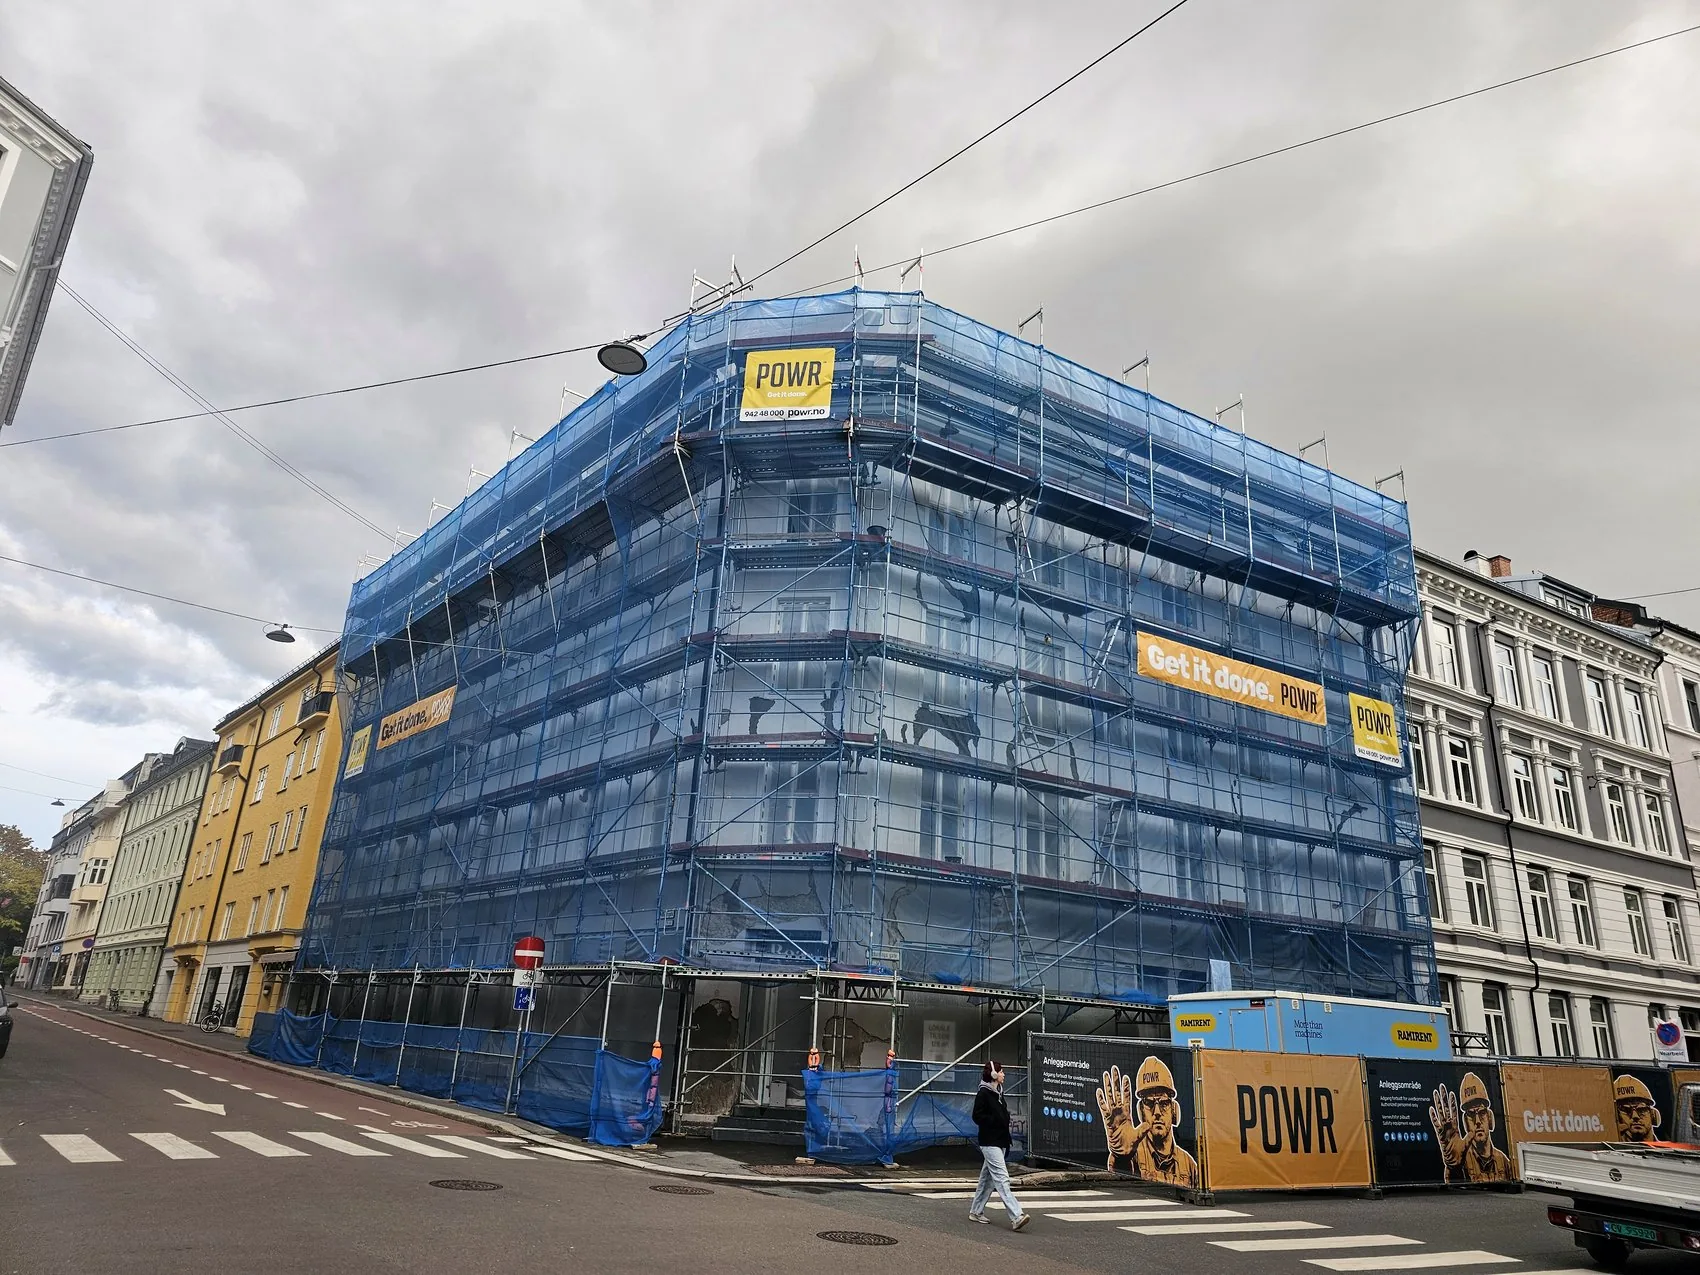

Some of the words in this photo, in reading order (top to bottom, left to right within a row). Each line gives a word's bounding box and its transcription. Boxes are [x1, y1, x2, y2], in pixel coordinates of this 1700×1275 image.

[756, 360, 822, 389] POWR
[787, 408, 826, 418] powr.no
[1147, 644, 1190, 679] Get
[1193, 656, 1212, 685] it
[1214, 666, 1275, 702] done.
[1280, 682, 1318, 715] POWR
[1357, 705, 1393, 738] POWR
[381, 722, 396, 741] Get
[1180, 1018, 1211, 1027] RAMIRENT
[1294, 1019, 1309, 1029] More
[1309, 1020, 1323, 1030] than
[1294, 1030, 1323, 1039] machines
[1397, 1029, 1433, 1043] RAMIRENT
[1043, 1057, 1089, 1069] Anleggsområde
[1142, 1071, 1160, 1084] POWR
[1379, 1080, 1422, 1091] Anleggsområde
[1616, 1085, 1636, 1096] POWR
[1236, 1084, 1338, 1154] POWR
[1523, 1109, 1551, 1133] Get
[1551, 1109, 1565, 1132] it
[1564, 1109, 1605, 1132] done.
